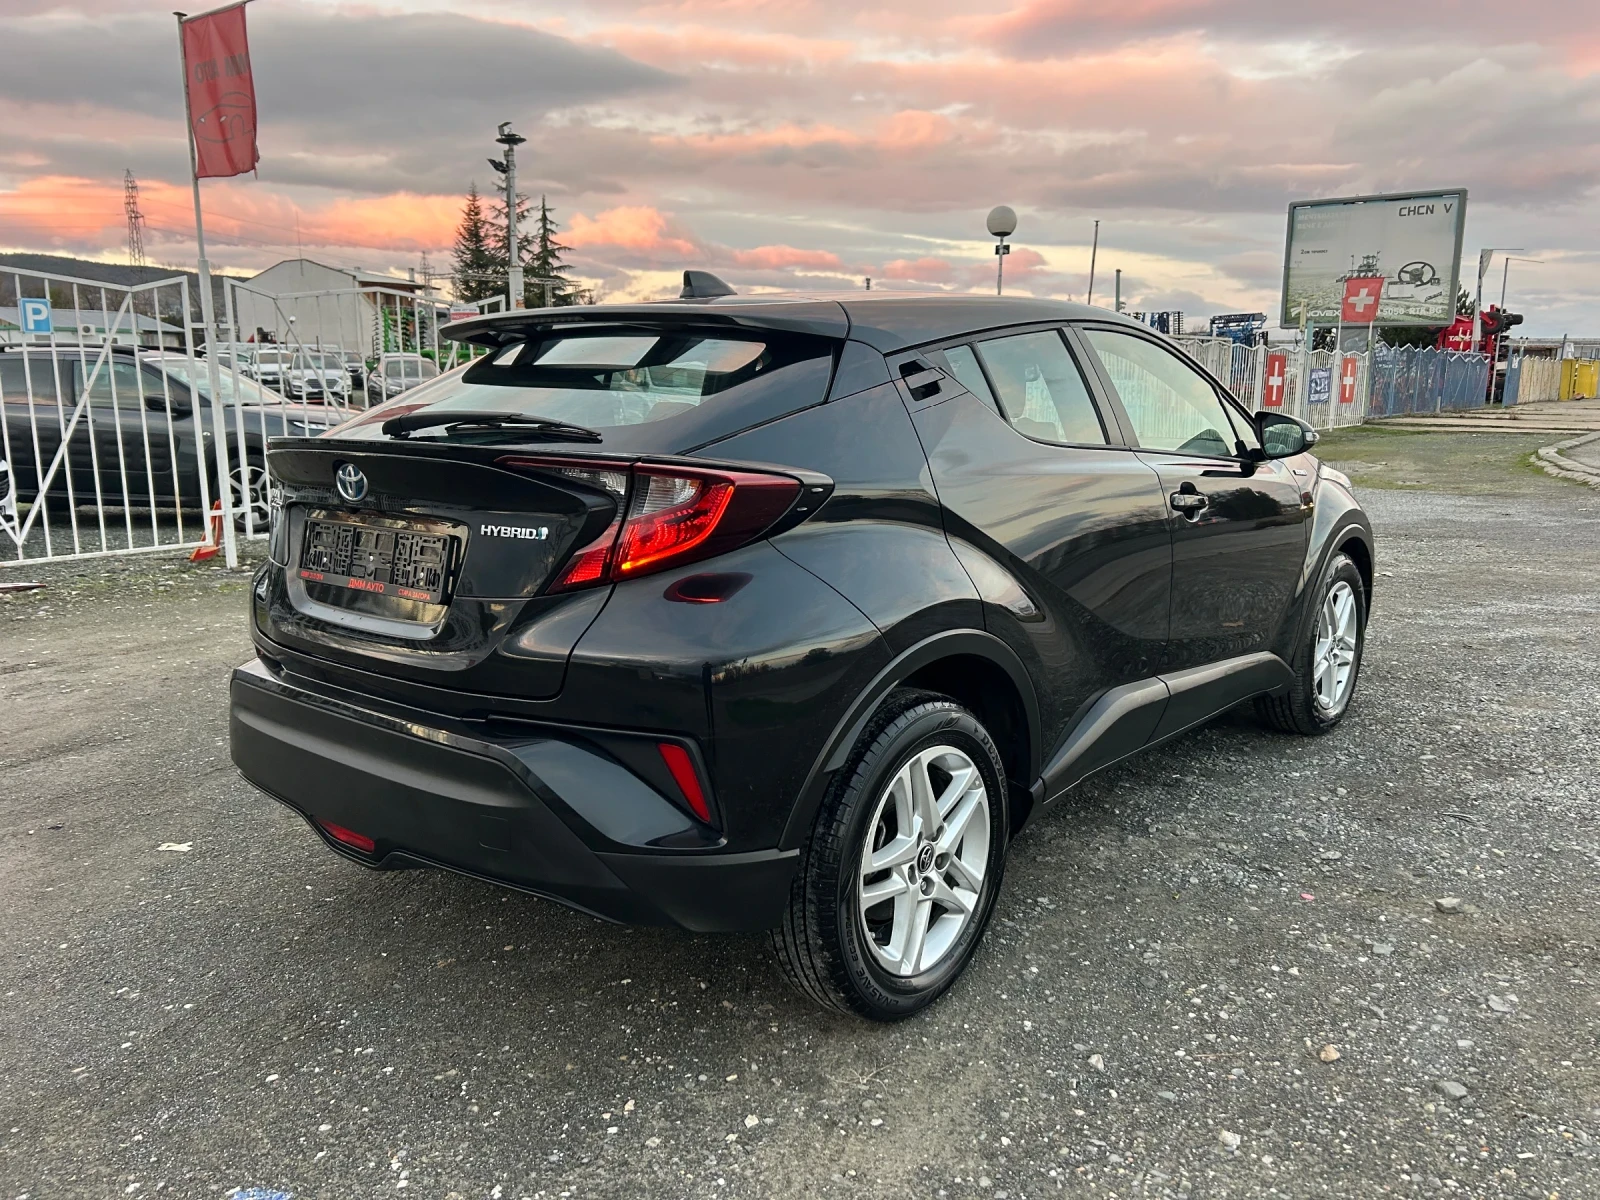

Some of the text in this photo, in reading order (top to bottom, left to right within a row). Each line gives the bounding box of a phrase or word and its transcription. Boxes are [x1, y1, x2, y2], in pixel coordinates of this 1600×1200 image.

[1399, 203, 1453, 216] CHCN V
[25, 303, 48, 329] P
[481, 525, 537, 539] HYBRID
